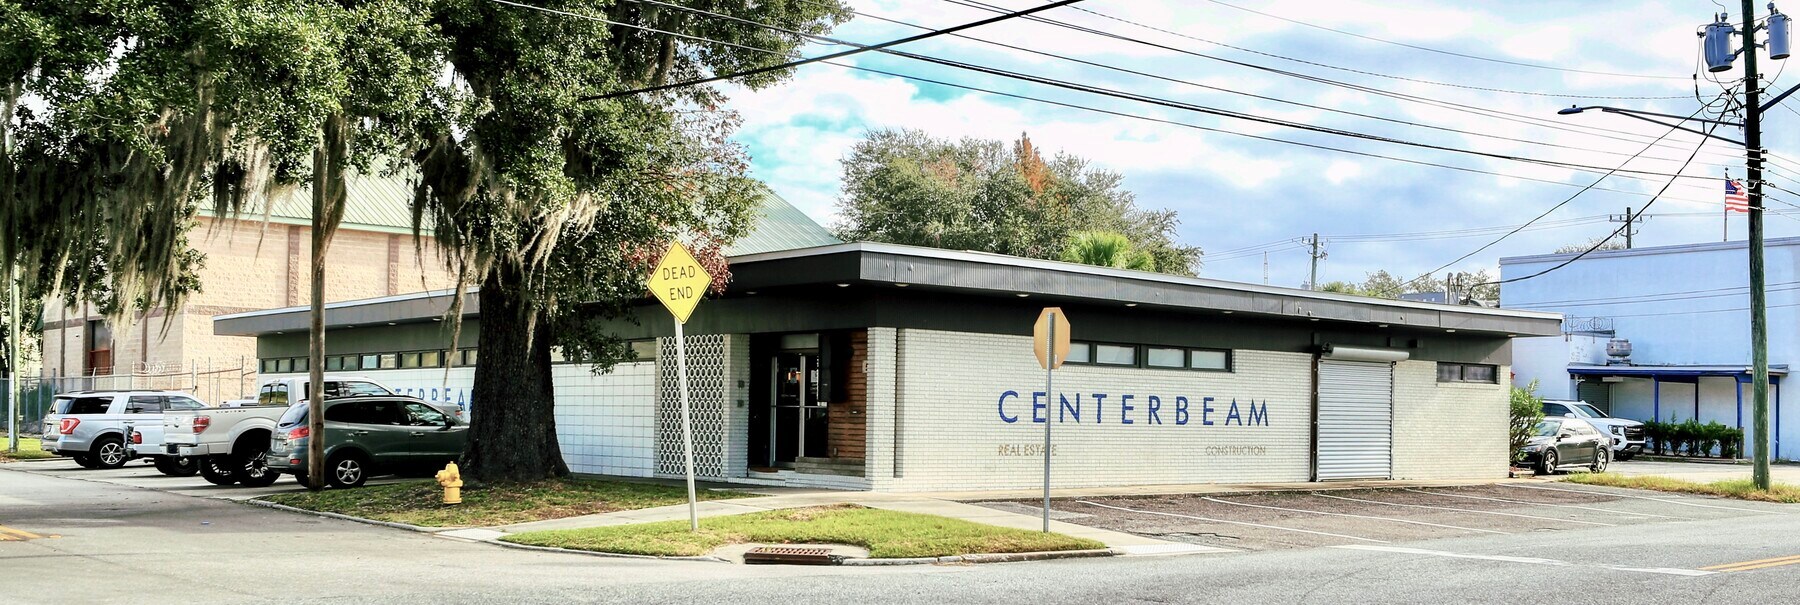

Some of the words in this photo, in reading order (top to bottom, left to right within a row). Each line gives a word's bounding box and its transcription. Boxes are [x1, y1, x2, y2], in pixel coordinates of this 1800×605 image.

[663, 266, 696, 281] DEAD
[670, 286, 693, 300] END
[998, 390, 1269, 427] CENTERBEAM
[998, 444, 1021, 456] REAL
[1024, 444, 1057, 456] ESTAE
[1206, 445, 1266, 456] CONSTRUCTION
